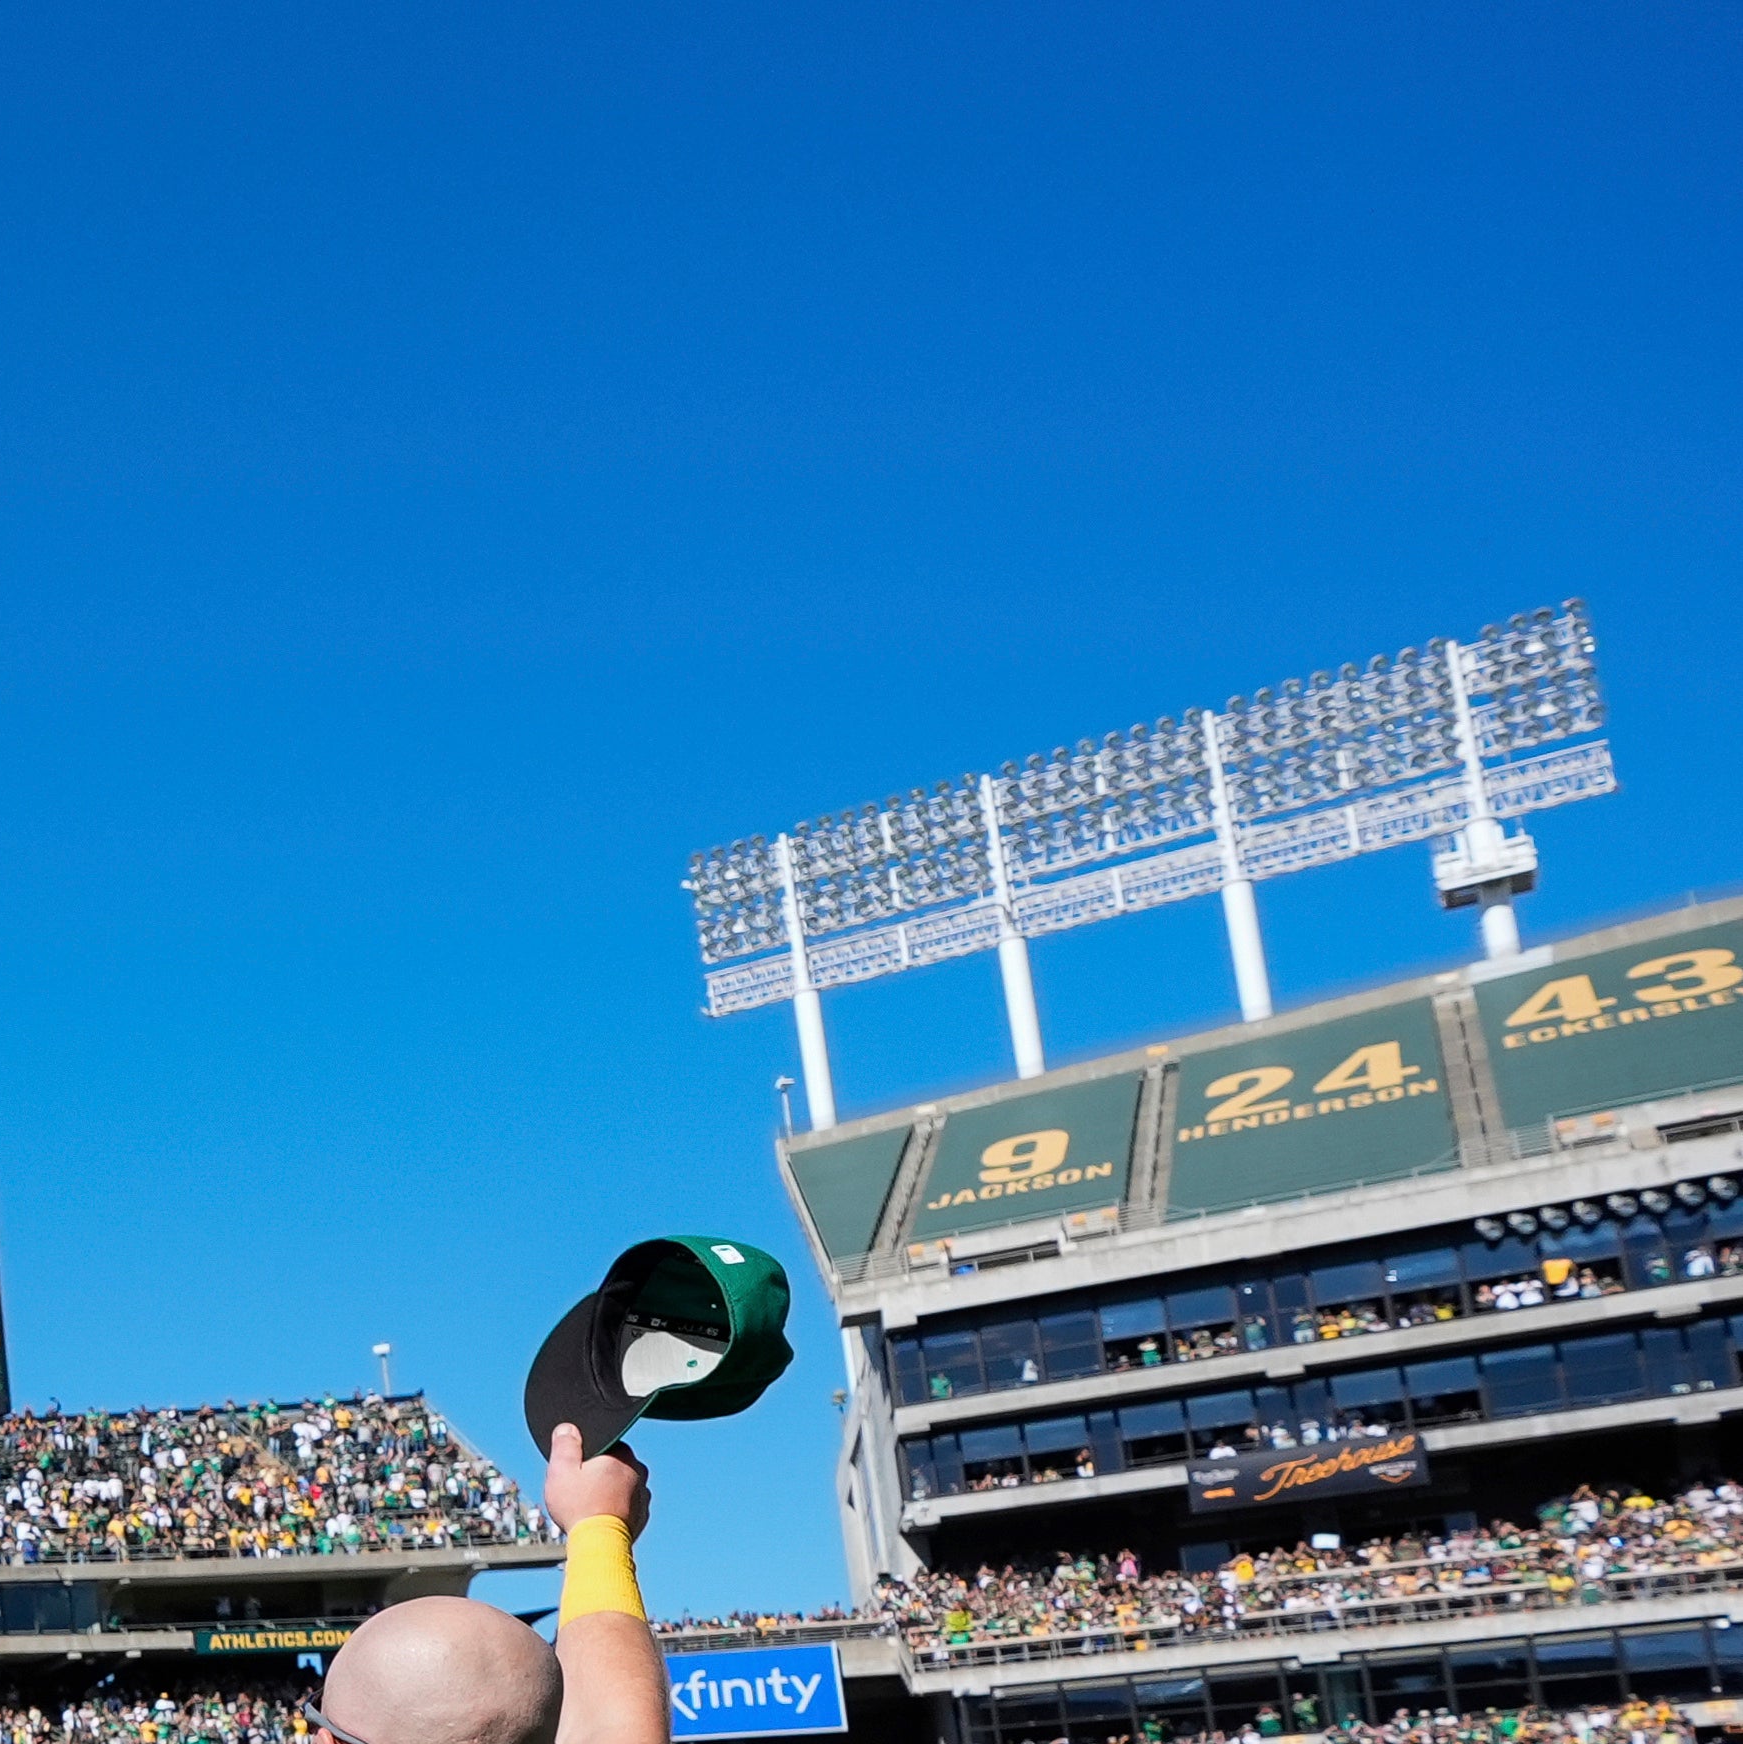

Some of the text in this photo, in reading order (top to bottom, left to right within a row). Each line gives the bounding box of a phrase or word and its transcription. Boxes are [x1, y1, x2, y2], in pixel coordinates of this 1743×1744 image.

[1502, 986, 1743, 1049] ECKERSLE
[1504, 948, 1743, 1028] 43
[1177, 1078, 1439, 1143] HENDERSON
[1204, 1041, 1421, 1124] 24
[927, 1161, 1113, 1211] JACKSON
[978, 1128, 1070, 1184] 9
[210, 1630, 353, 1651] ATHLETICS.COM
